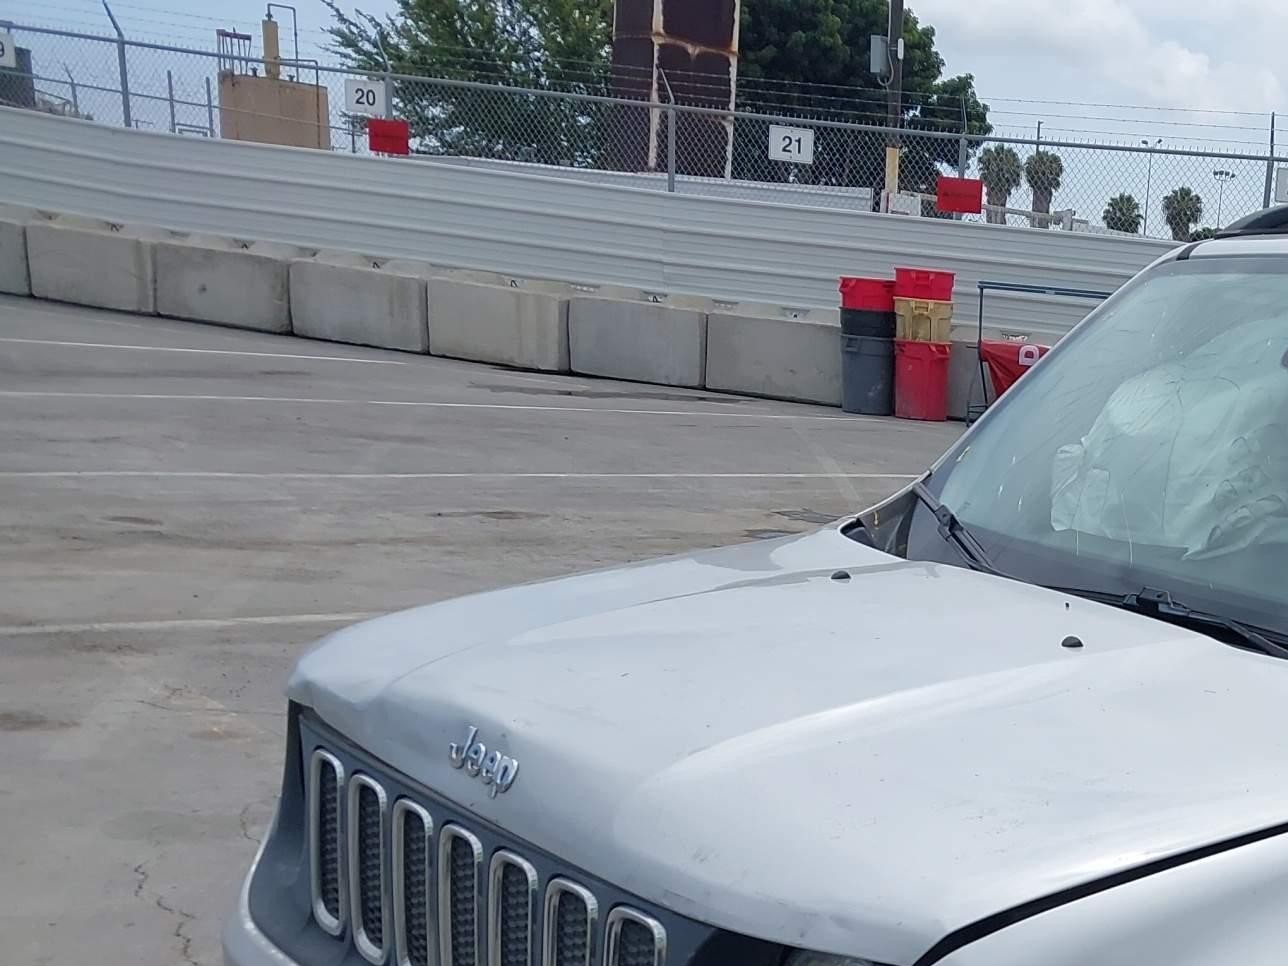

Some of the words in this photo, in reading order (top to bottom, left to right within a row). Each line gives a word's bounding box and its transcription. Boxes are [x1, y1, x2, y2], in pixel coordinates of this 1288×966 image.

[355, 88, 376, 106] 20
[782, 135, 802, 155] 21
[449, 725, 519, 798] Jeep
